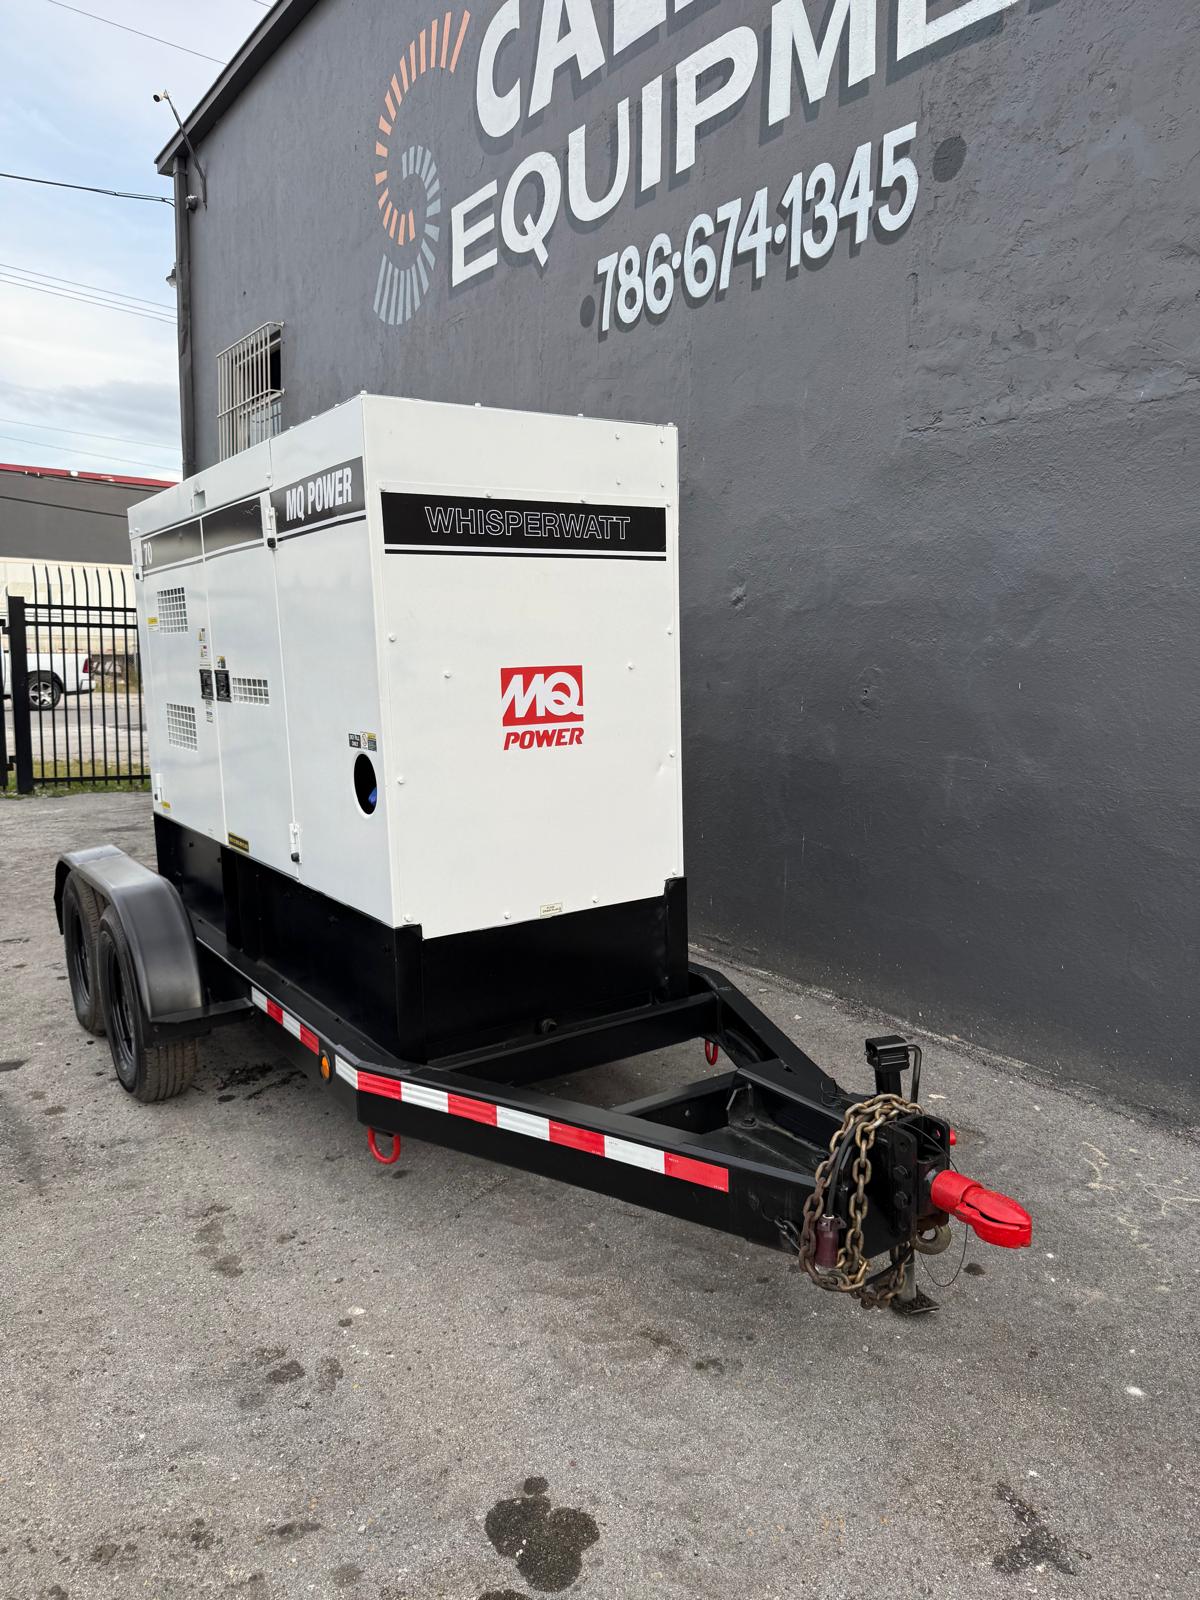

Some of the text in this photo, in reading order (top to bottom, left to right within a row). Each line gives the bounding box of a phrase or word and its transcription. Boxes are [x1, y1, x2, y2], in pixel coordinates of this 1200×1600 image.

[477, 0, 693, 137] CA
[286, 467, 352, 522] MQ POWER
[424, 506, 631, 540] WHISPERWATT
[143, 541, 153, 566] 70
[501, 671, 584, 718] MQ
[503, 727, 584, 751] POWER
